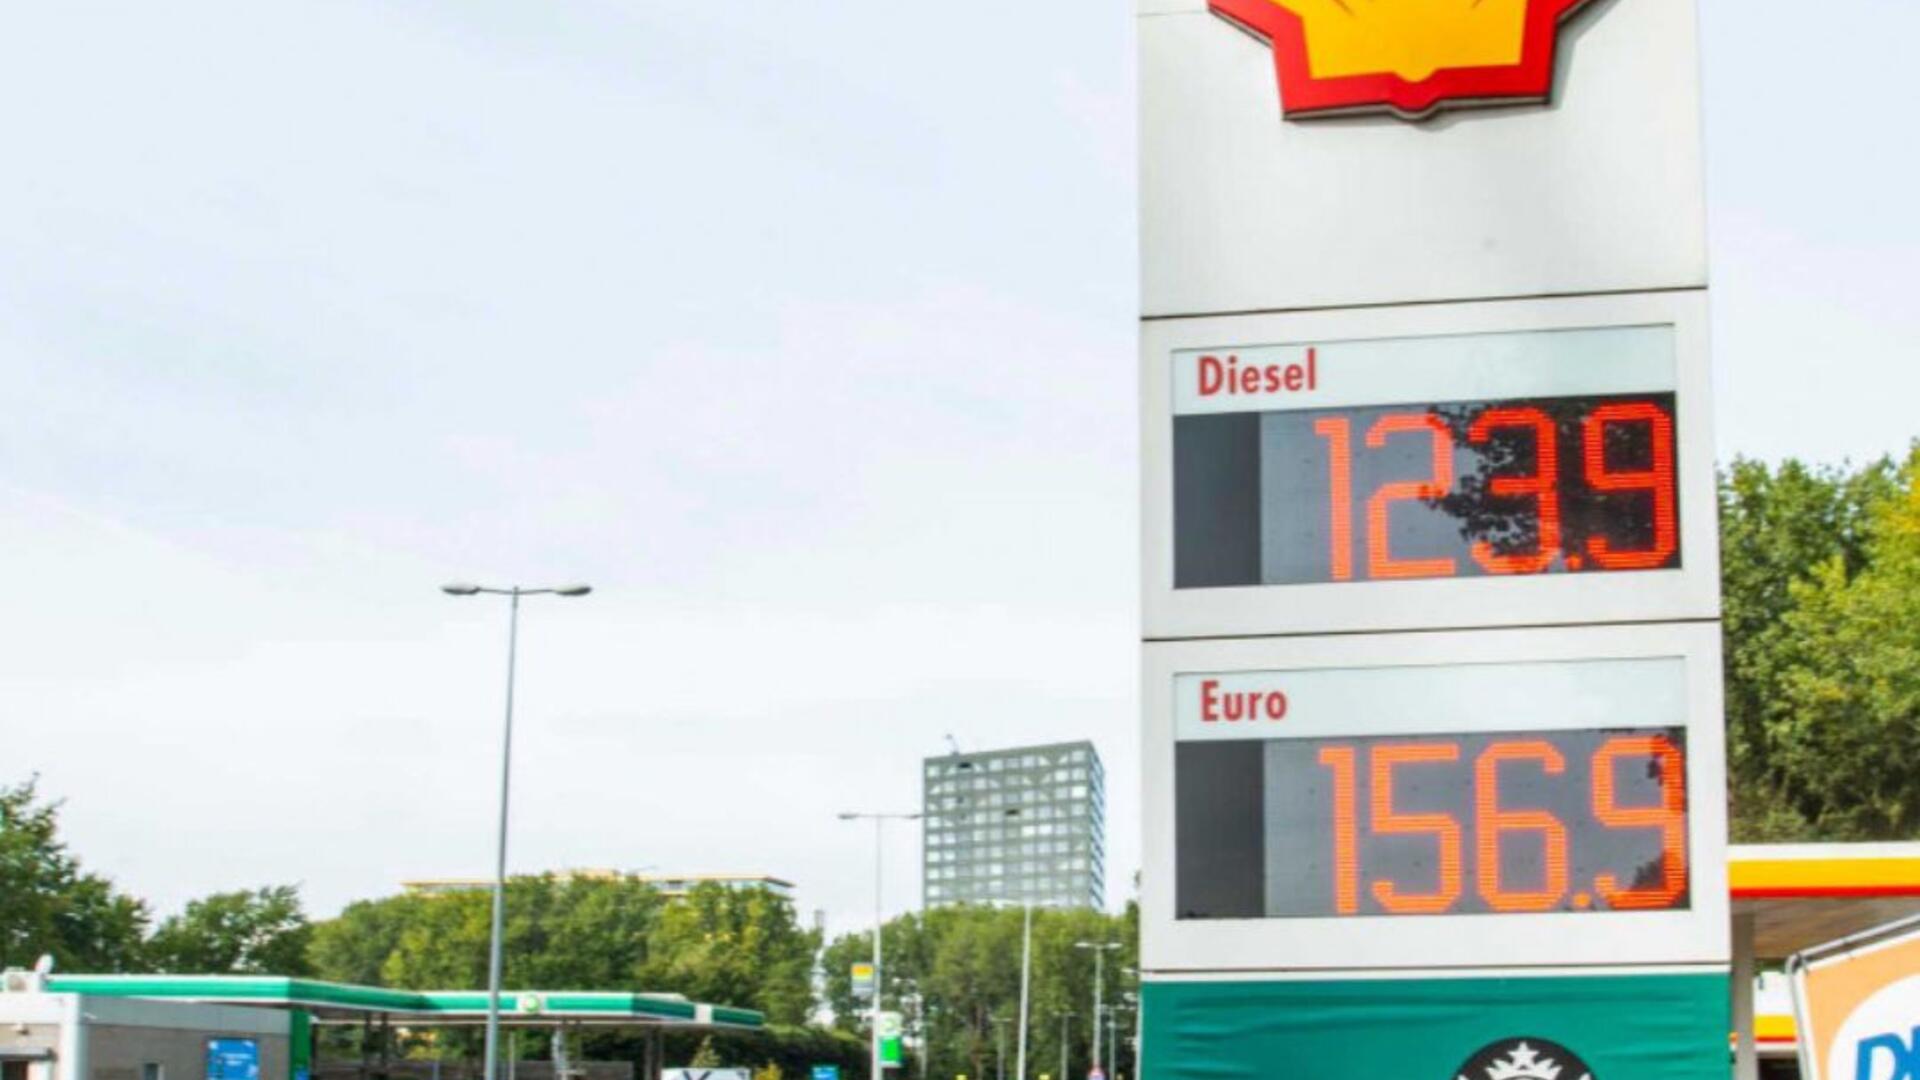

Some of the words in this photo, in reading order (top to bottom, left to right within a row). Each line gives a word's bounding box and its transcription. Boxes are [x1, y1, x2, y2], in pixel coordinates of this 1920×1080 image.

[1198, 348, 1317, 395] Diesel
[1314, 402, 1678, 581] 123.9
[1200, 680, 1288, 722] Euro
[1318, 735, 1688, 916] 156.9
